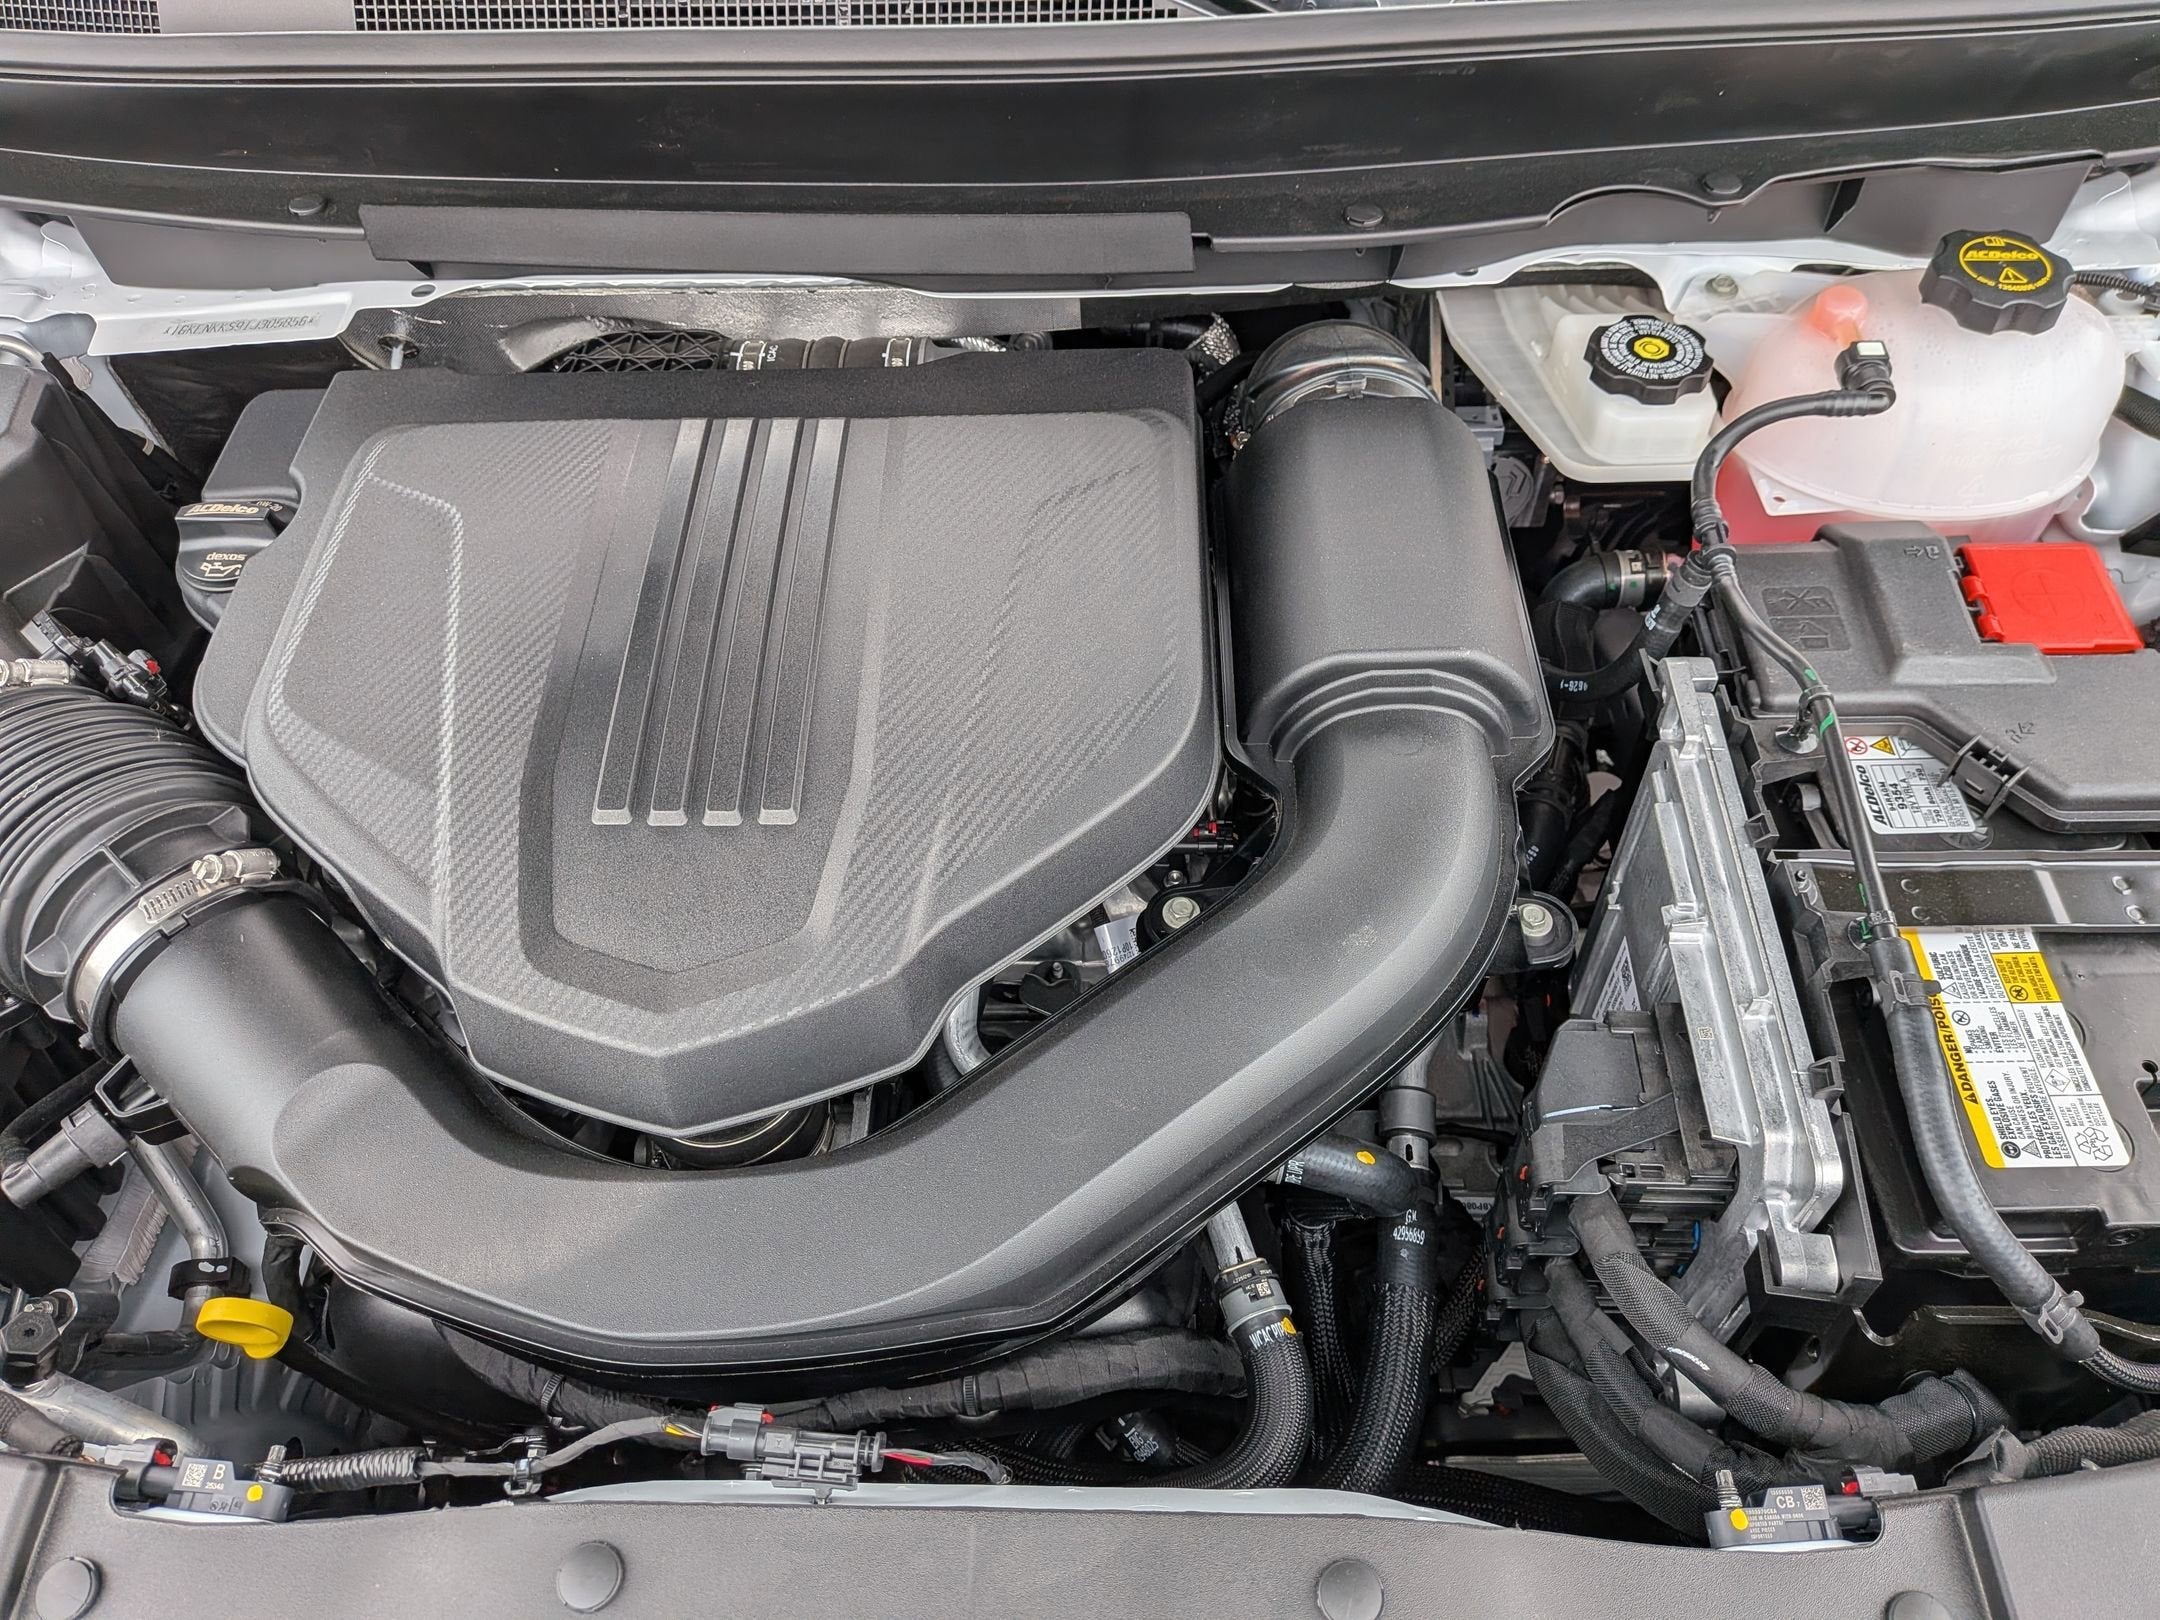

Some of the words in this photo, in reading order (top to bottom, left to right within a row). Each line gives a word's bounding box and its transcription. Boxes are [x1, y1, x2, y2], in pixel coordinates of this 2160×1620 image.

[188, 503, 260, 515] ACDelco
[206, 552, 248, 561] dexos
[1855, 764, 1888, 827] ACDelco
[1888, 782, 1908, 809] 9354
[1928, 951, 1946, 979] SULFURIC
[1957, 981, 1971, 998] CAUSE
[2017, 1066, 2036, 1092] PEUVENT
[1986, 1080, 2002, 1101] GASES
[2010, 1095, 2021, 1103] OR
[2006, 1105, 2020, 1125] CAUSE
[2026, 1110, 2039, 1122] LES
[2029, 1094, 2051, 1129] EXPLOSIFS
[2038, 1096, 2055, 1119] RENDRE
[1992, 1116, 2008, 1139] SHIELD
[1995, 1103, 2017, 1139] EXPLOSIVE
[2014, 1105, 2035, 1139] BLINDNESS
[2049, 1121, 2059, 1129] OU
[2014, 1126, 2026, 1139] CAN
[2044, 1131, 2057, 1144] GAZ
[2050, 1146, 2063, 1158] LES
[2053, 1131, 2071, 1158] BLESSER
[213, 1463, 225, 1480] B
[1776, 1496, 1795, 1509] CB
